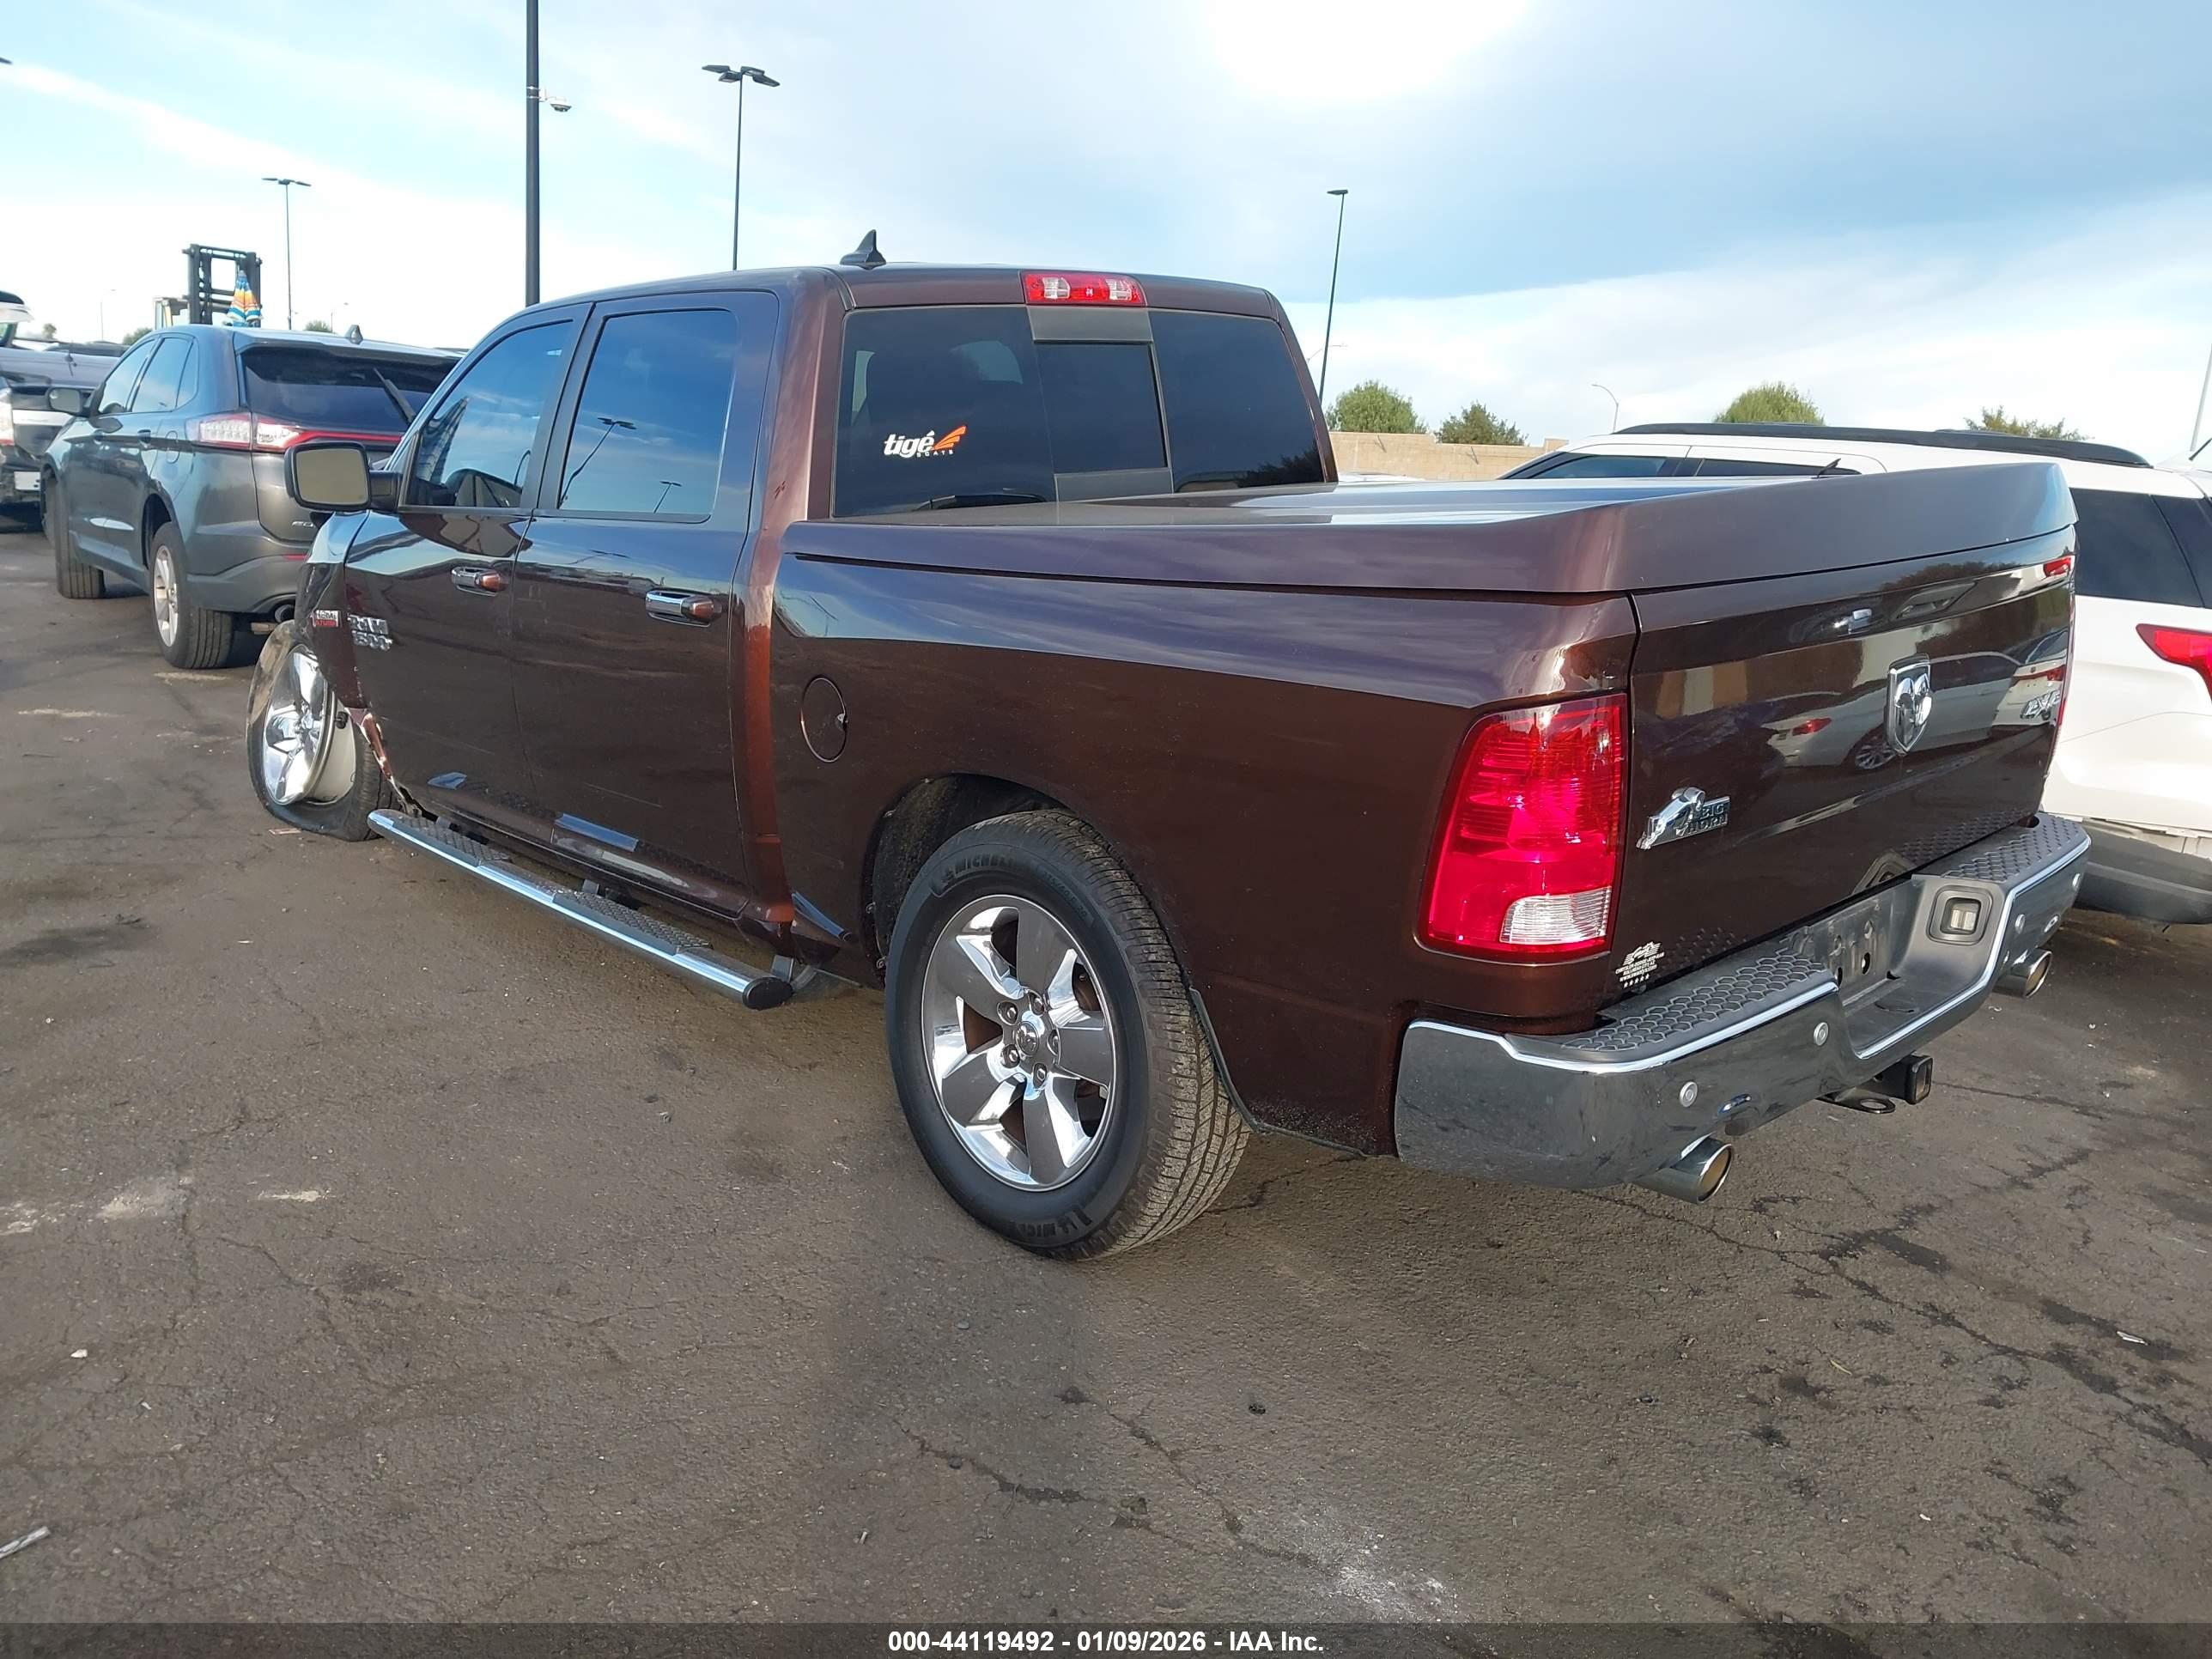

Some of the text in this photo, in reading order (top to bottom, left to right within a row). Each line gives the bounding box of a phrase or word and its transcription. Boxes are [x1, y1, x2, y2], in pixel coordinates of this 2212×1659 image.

[884, 430, 935, 458] tigé
[347, 614, 388, 635] RAM
[1700, 804, 1725, 820] BIG
[1686, 813, 1729, 836] HORN
